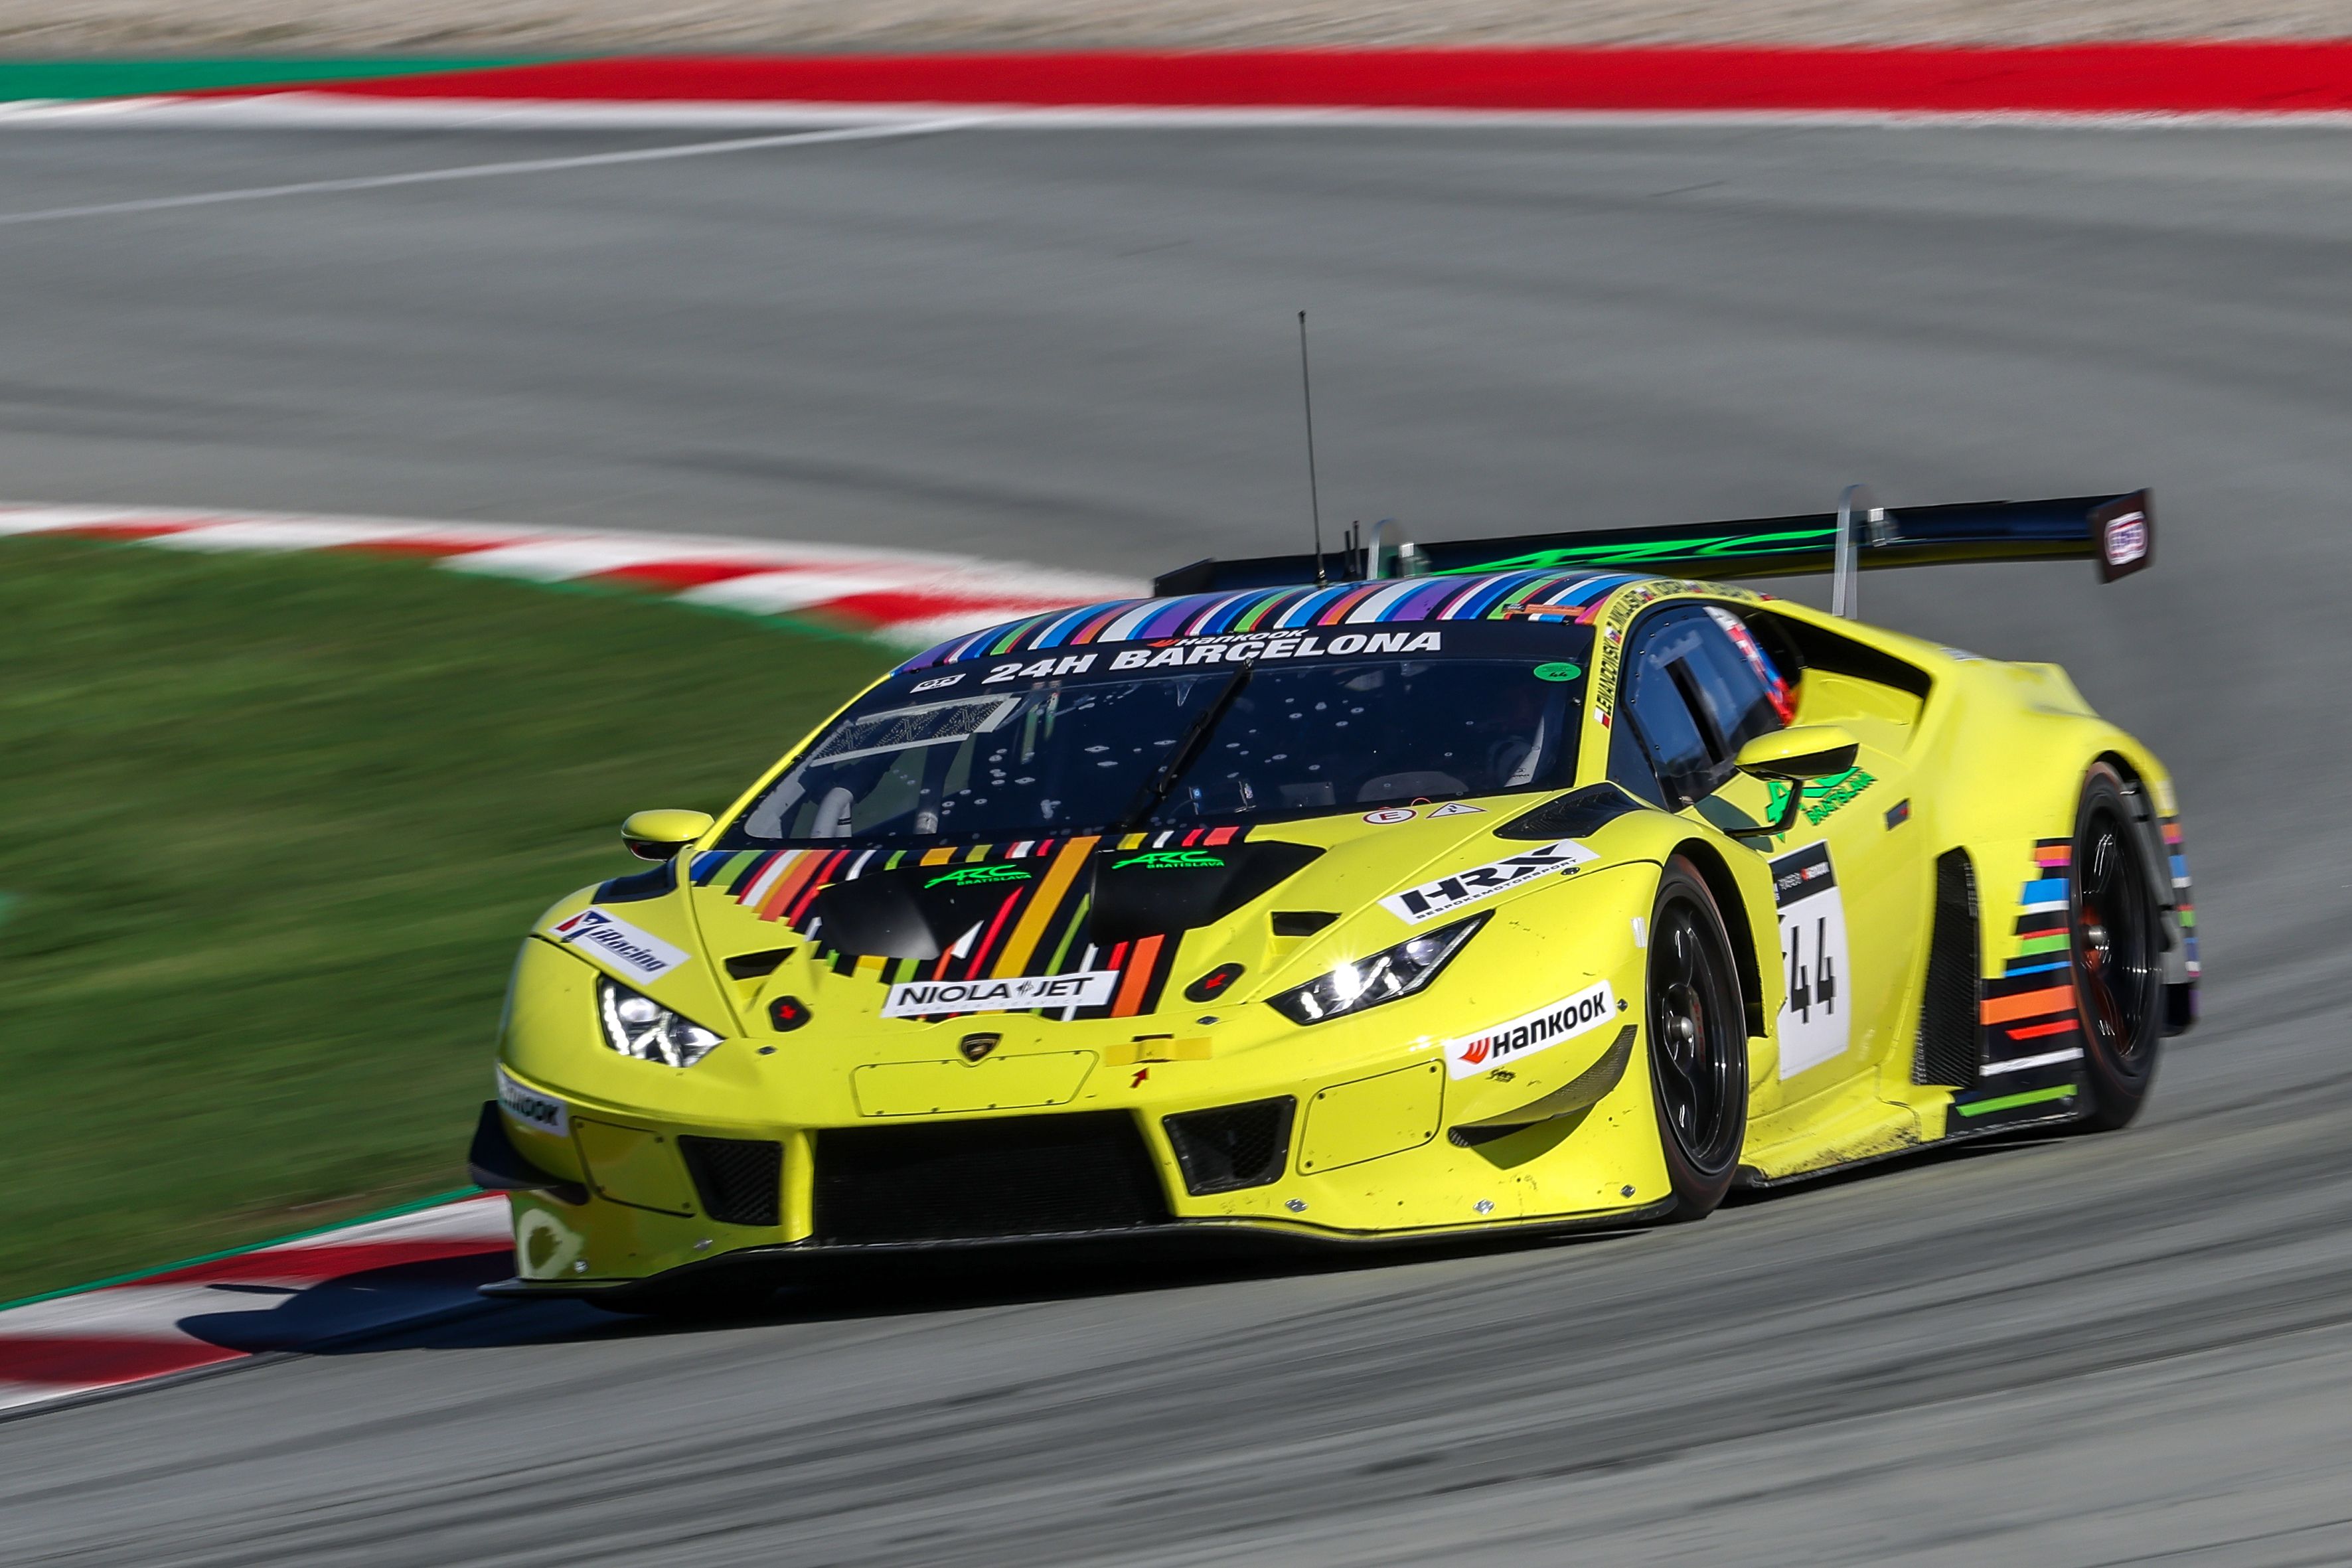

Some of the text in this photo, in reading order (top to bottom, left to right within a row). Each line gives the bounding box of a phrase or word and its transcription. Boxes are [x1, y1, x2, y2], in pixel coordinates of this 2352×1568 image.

[981, 631, 1442, 684] 24H BARCELONA
[1379, 811, 1399, 821] E
[1146, 860, 1225, 869] BRATISLAVA
[1399, 843, 1573, 915] HRX
[957, 873, 1032, 886] BRATISLAVA
[1790, 917, 1837, 1024] 44
[898, 982, 1009, 1006] NIOLA
[1031, 977, 1095, 997] JET
